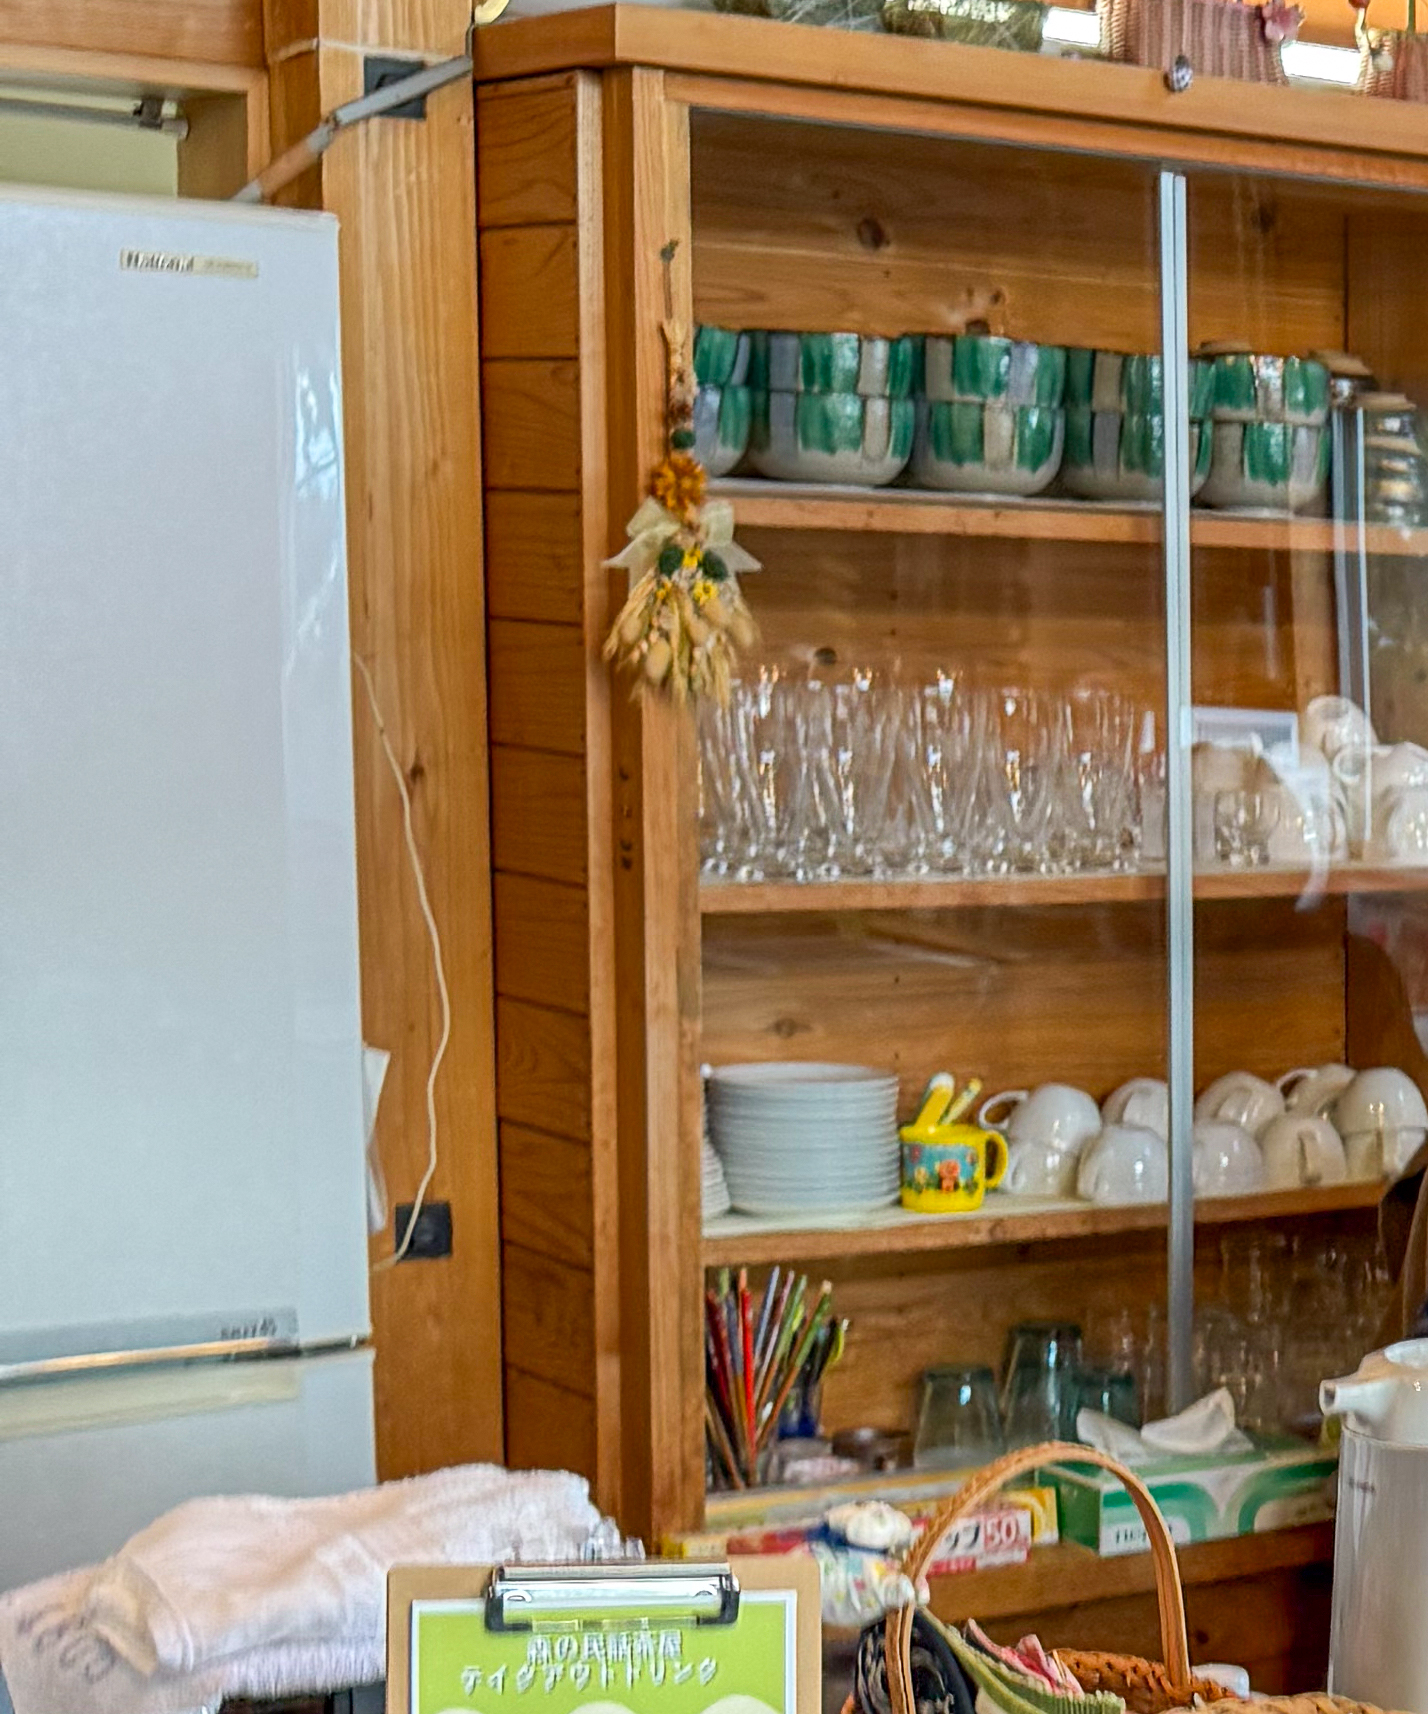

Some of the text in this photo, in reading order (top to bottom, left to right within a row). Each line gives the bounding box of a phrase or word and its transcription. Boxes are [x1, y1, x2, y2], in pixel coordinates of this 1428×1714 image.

[526, 1629, 682, 1665] 森の民話茶屋
[461, 1656, 717, 1696] テイクアウトドリンク
